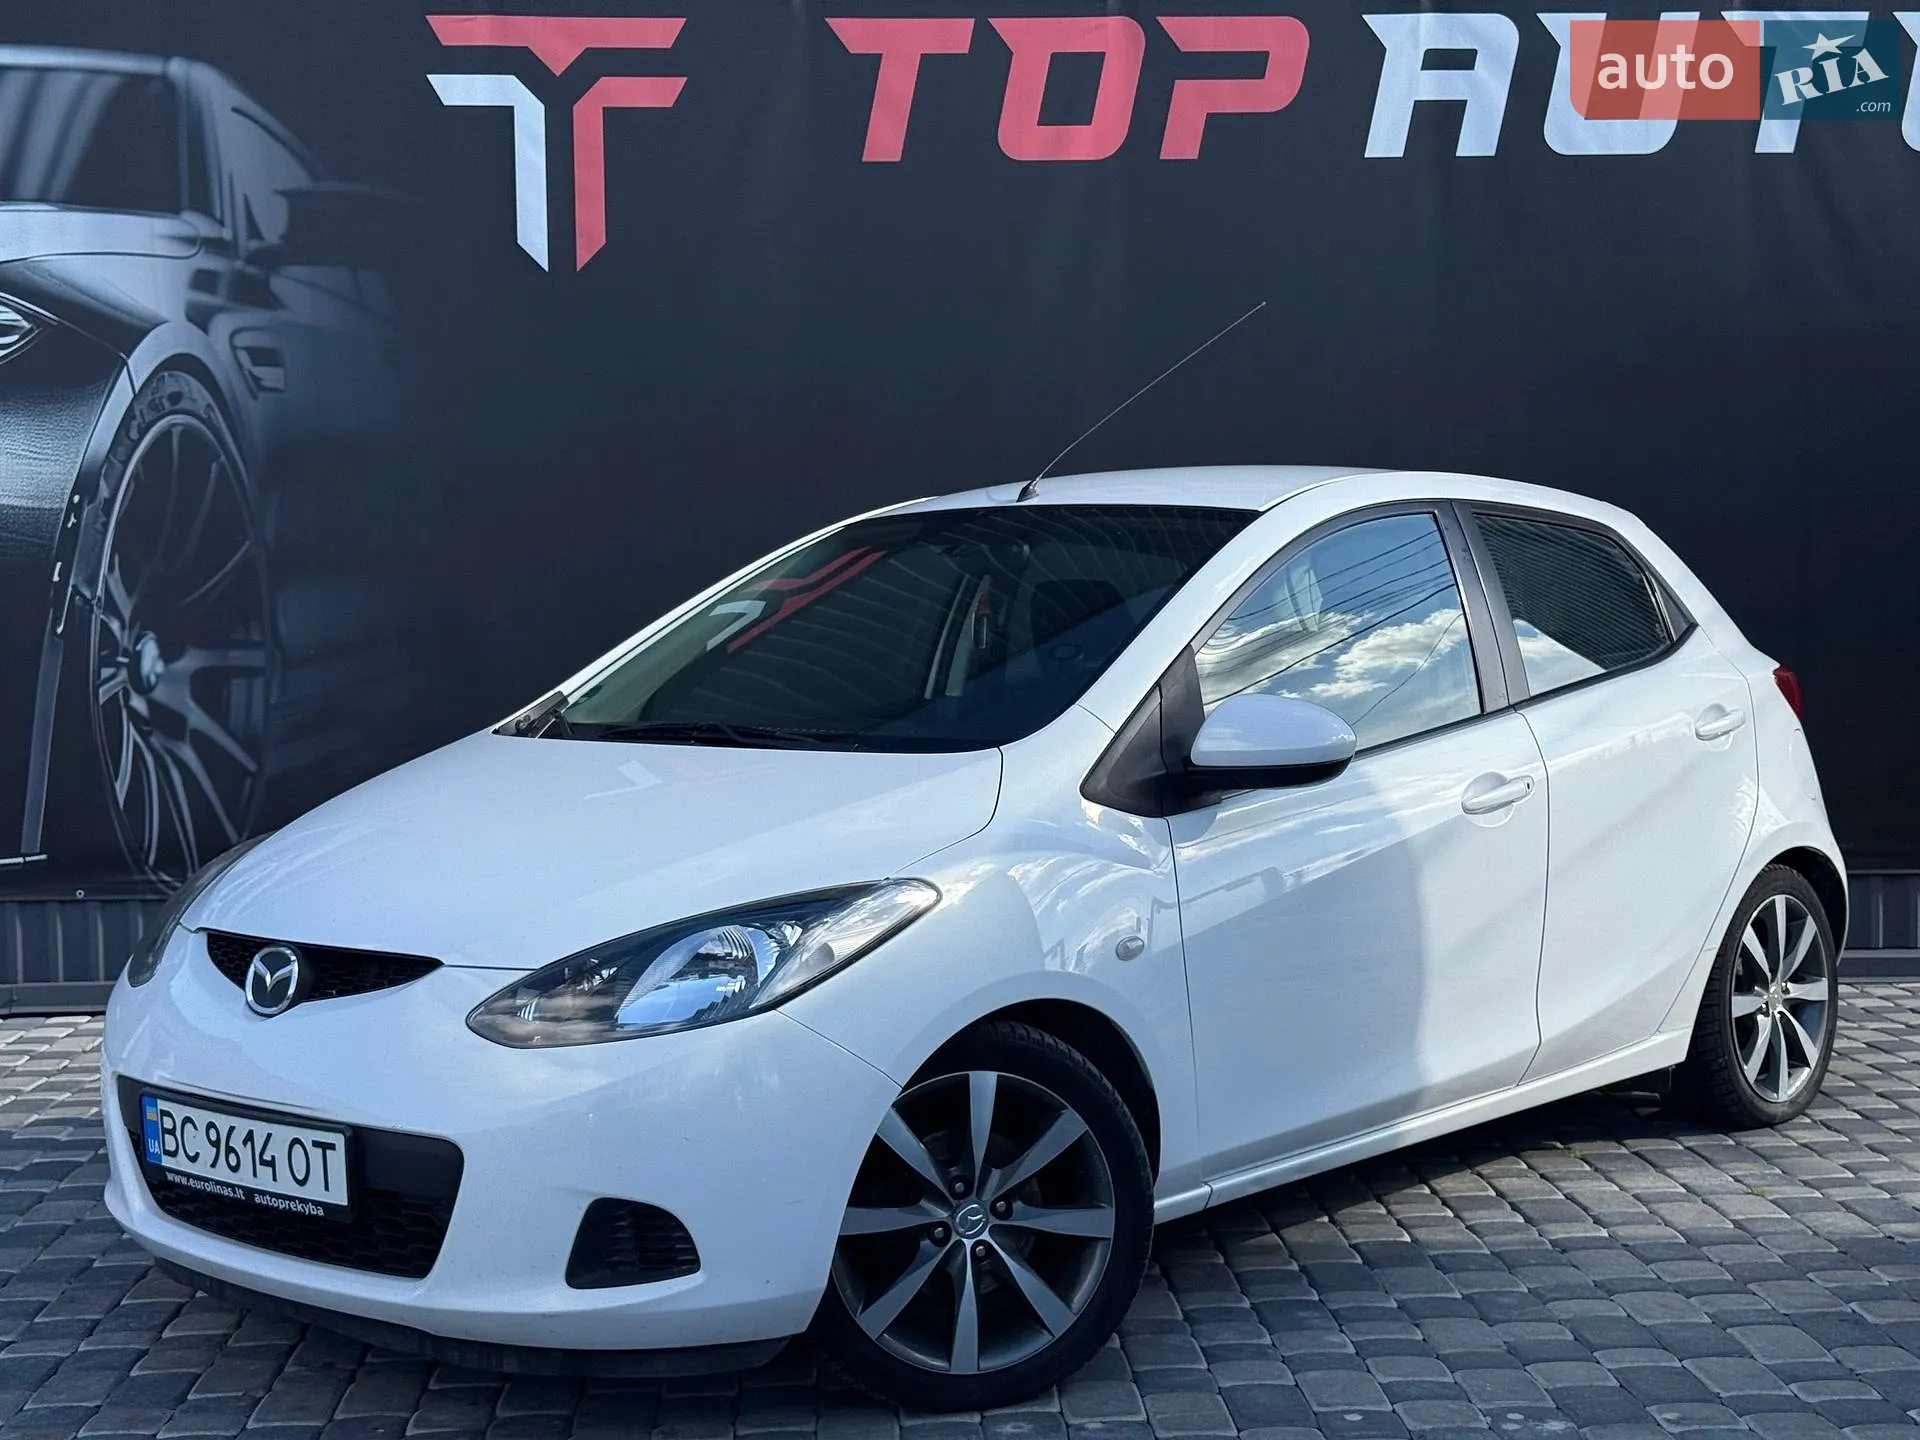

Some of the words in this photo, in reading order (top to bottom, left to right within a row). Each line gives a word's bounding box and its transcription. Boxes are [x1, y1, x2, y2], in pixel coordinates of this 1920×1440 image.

[824, 15, 1311, 162] TOP
[1361, 10, 1920, 159] AUT
[148, 1137, 162, 1155] UA
[164, 1171, 246, 1201] www.eurolinas.lt
[253, 1192, 325, 1217] autoprekyba
